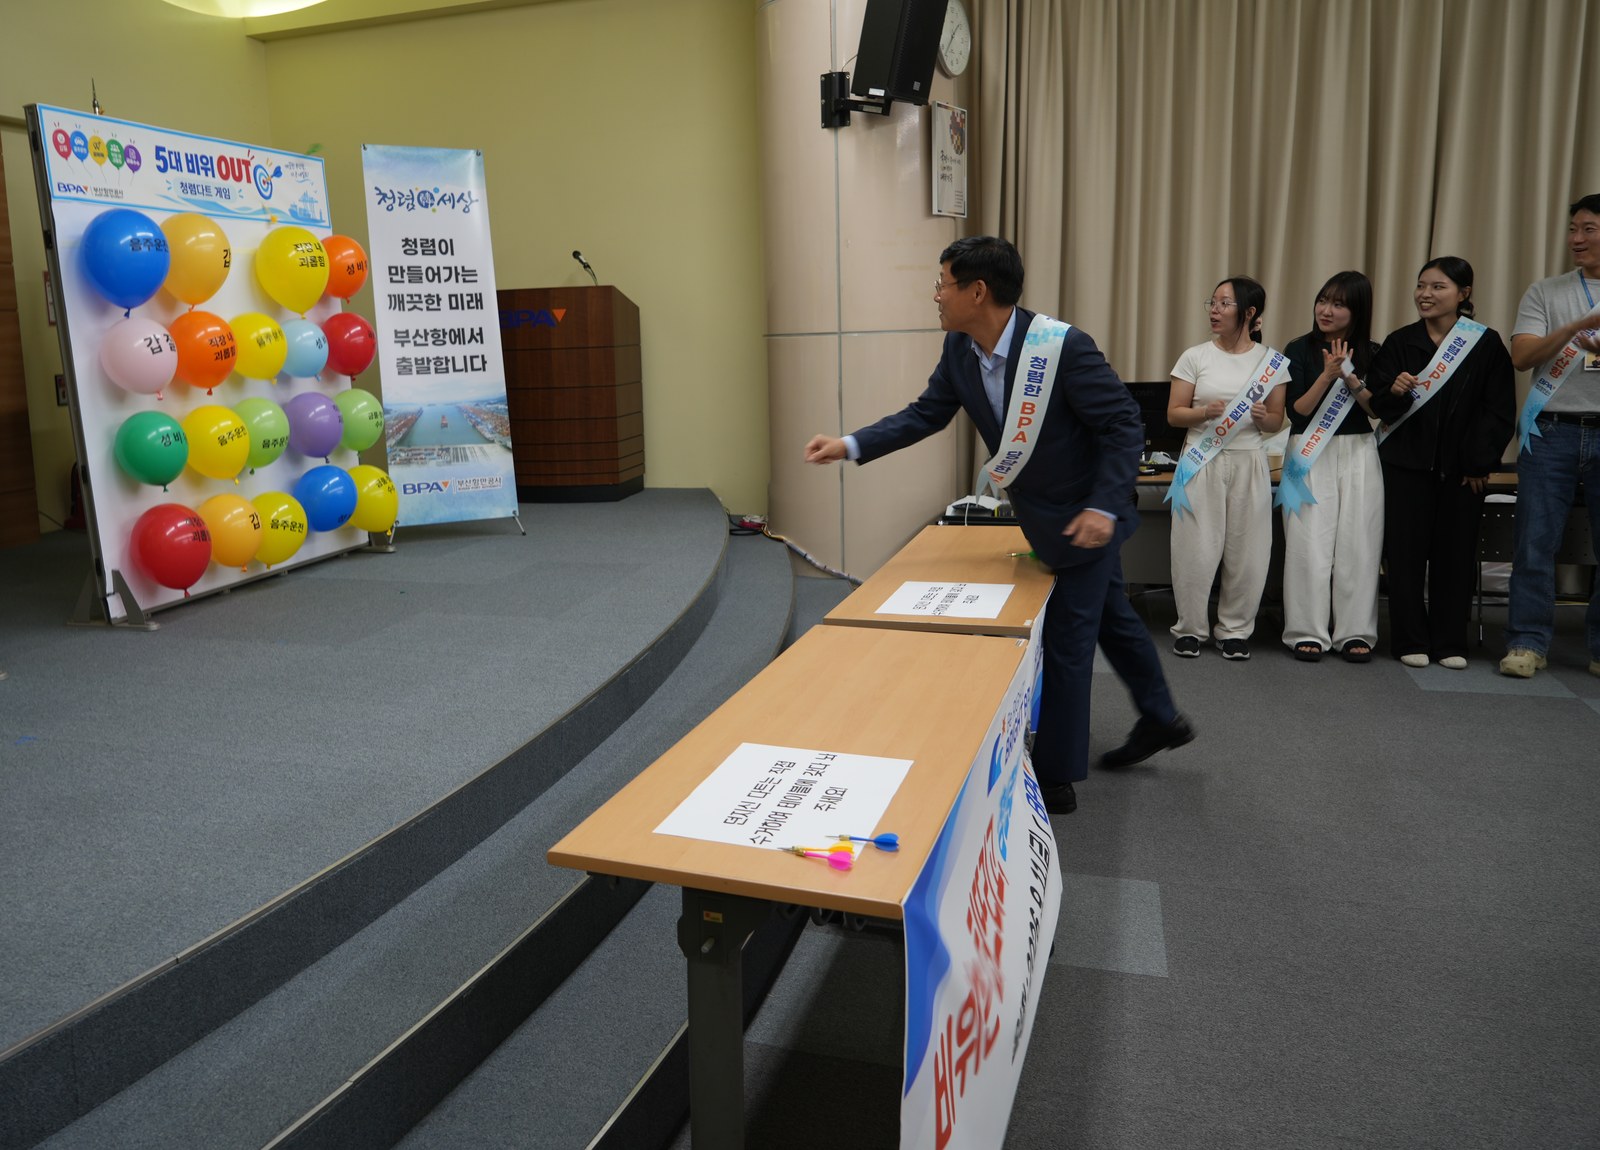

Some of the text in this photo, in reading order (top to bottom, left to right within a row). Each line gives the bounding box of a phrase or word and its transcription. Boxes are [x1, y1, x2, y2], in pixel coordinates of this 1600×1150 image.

[155, 145, 183, 173] 5대
[185, 152, 216, 179] 비위
[216, 154, 252, 184] OUT
[57, 182, 86, 194] BPA
[179, 181, 231, 200] 청렴다트 게임
[374, 186, 415, 212] 청렴
[437, 190, 479, 213] 세상
[293, 241, 314, 254] 직장
[401, 237, 455, 256] 청렴이
[299, 255, 326, 269] 괴롭힘
[388, 265, 478, 284] 만들어가는
[387, 292, 484, 312] 깨끗한 미래
[144, 334, 162, 355] 갑
[208, 336, 226, 349] 직장
[394, 327, 485, 348] 부산항에서
[396, 354, 488, 376] 출발합니다
[1420, 336, 1468, 391] 청렴한 BPA
[1549, 344, 1578, 379] 부산항
[1023, 355, 1048, 398] 청렴한
[1011, 401, 1036, 444] BPA
[402, 482, 443, 495] BPA
[270, 518, 304, 534] 음주운전
[723, 760, 796, 826] 던지신 다트는 직접
[749, 810, 793, 845] 수거하여
[777, 778, 818, 809] 테이블에
[803, 762, 831, 778] 갖다
